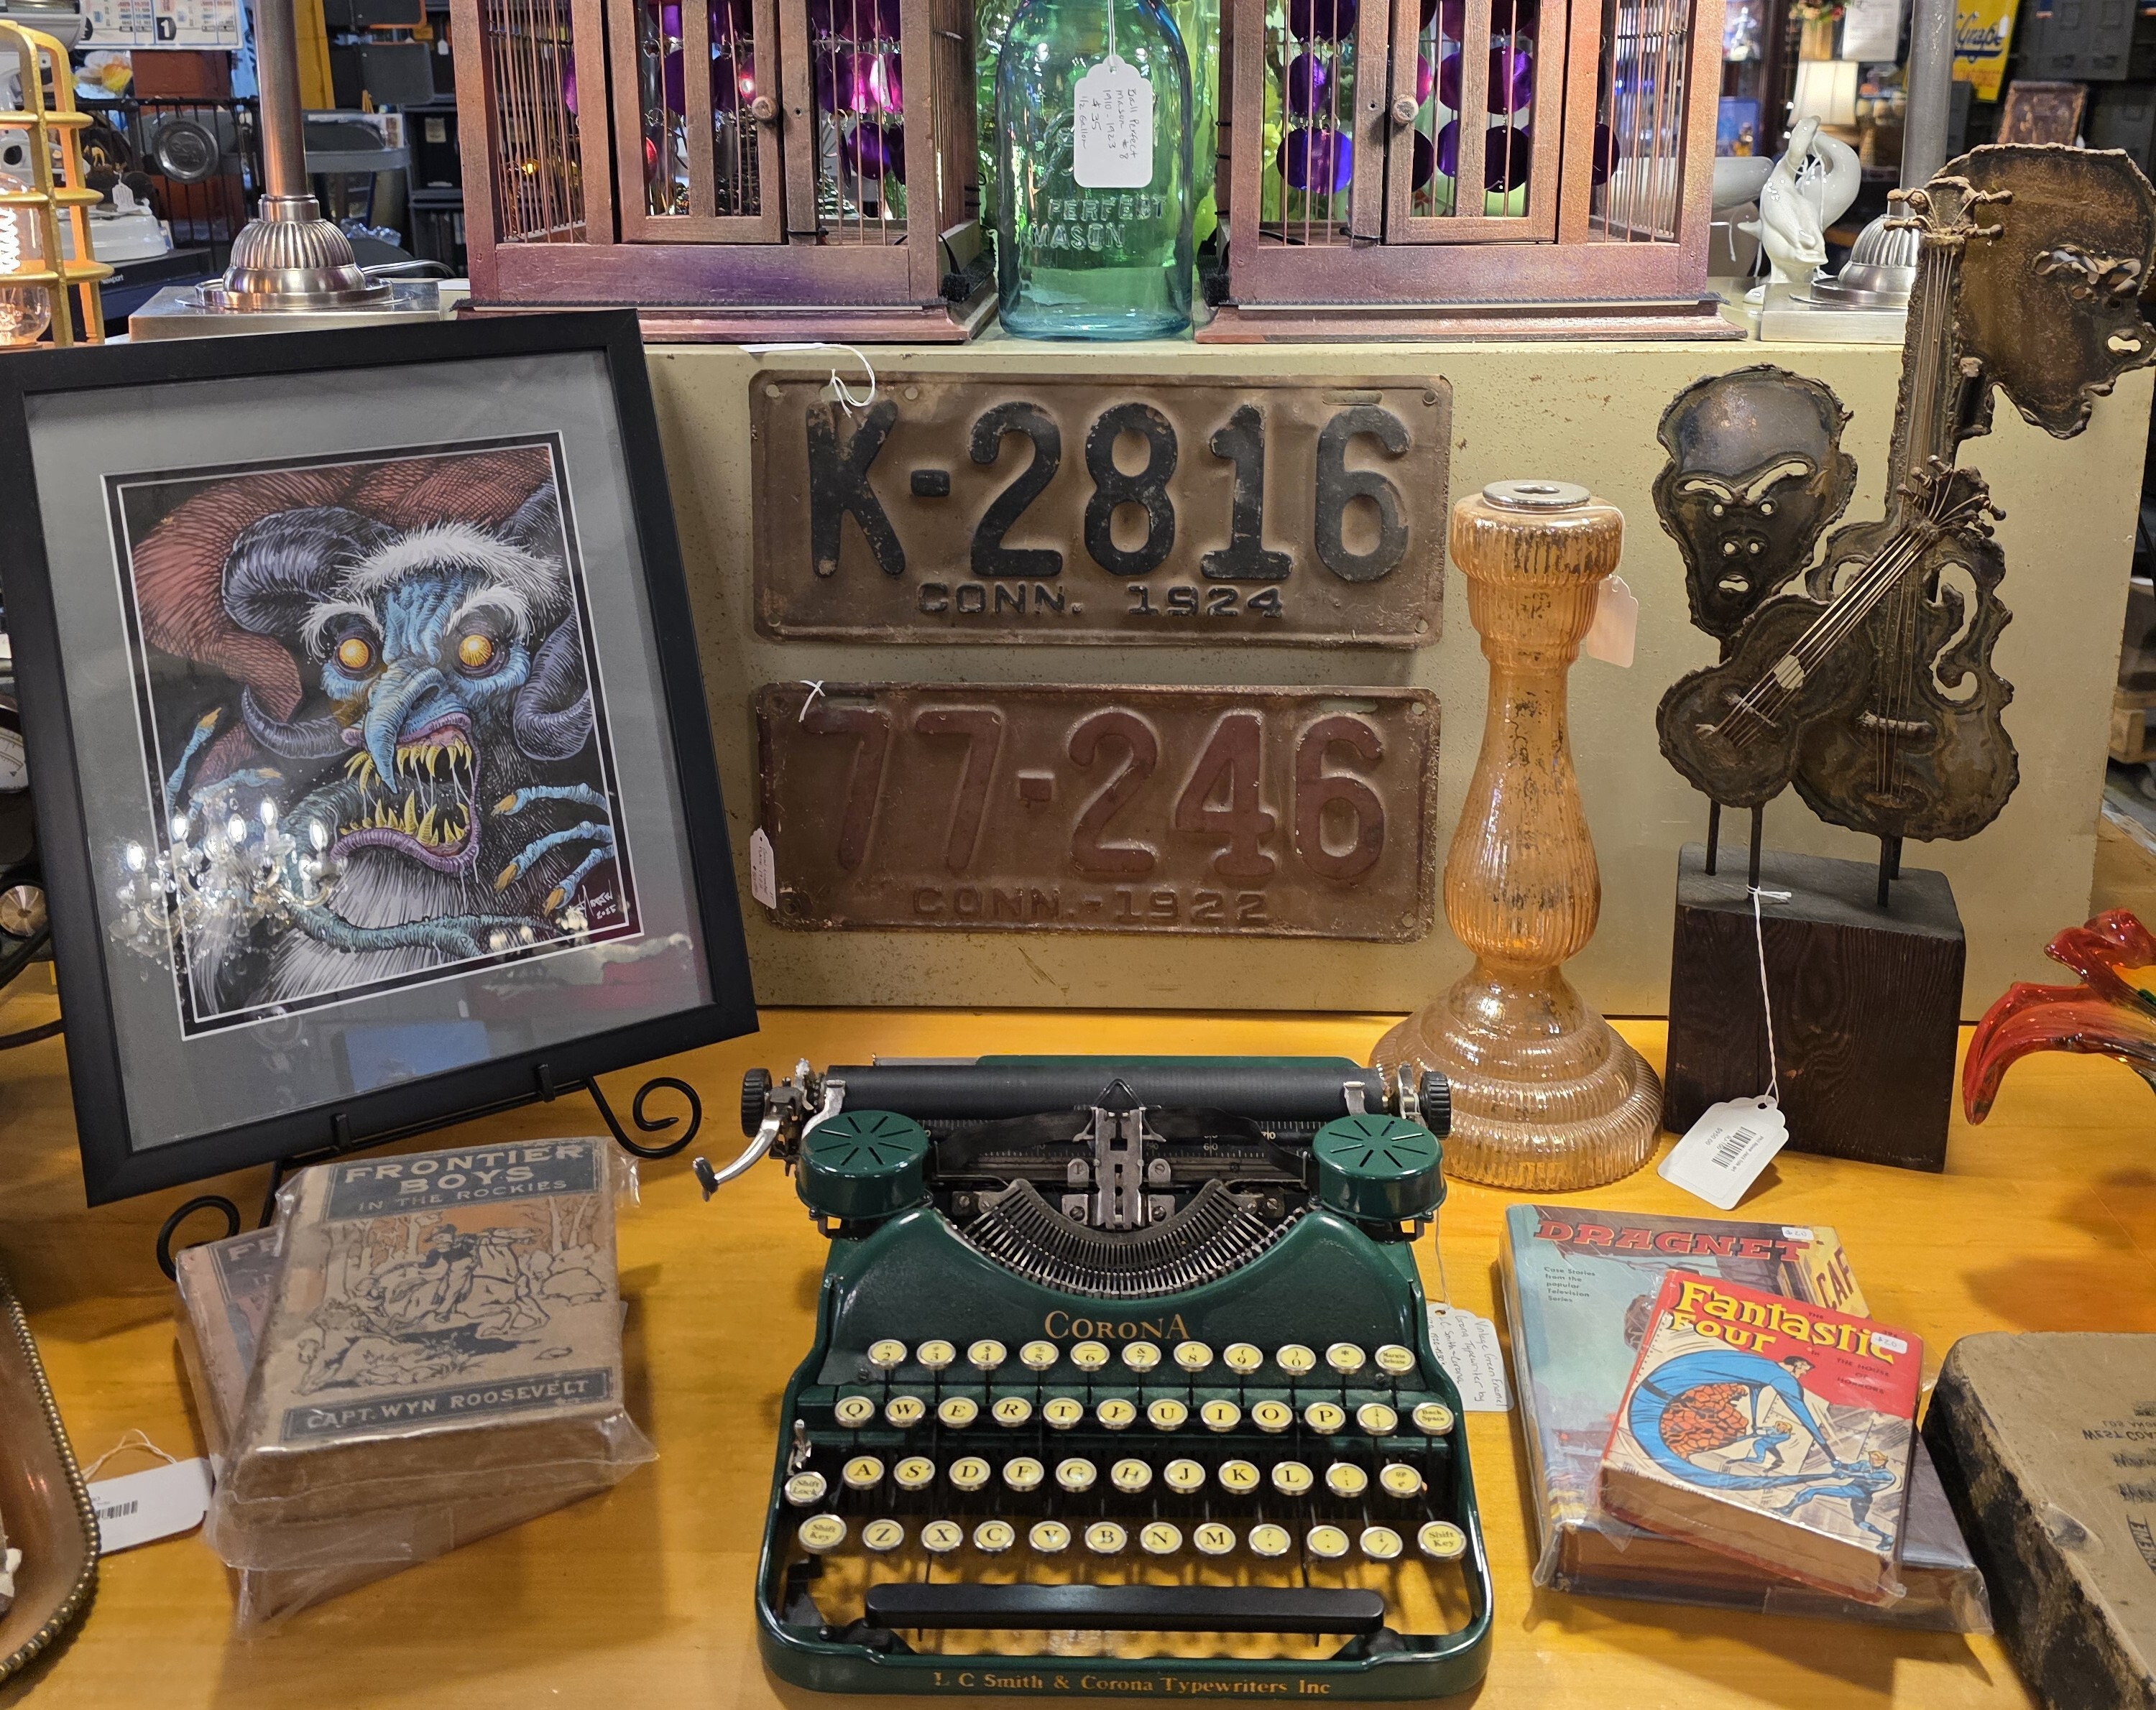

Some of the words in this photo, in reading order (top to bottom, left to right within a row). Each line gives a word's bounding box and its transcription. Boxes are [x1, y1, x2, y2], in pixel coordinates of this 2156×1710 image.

[160, 19, 170, 38] 1
[1102, 90, 1112, 109] 1910
[1128, 88, 1138, 113] Ball
[1105, 123, 1116, 149] 1923
[1128, 119, 1140, 159] Perfect
[1047, 194, 1167, 222] PERFECT
[1028, 222, 1125, 251] MASON
[806, 399, 1412, 583] K-2816
[917, 583, 1083, 616] CONN.
[1128, 583, 1284, 619] 1924
[802, 707, 1385, 879] 77-246
[345, 1144, 586, 1184] FRONTIER
[400, 1166, 535, 1195] BOYS
[359, 1200, 384, 1212] IN
[397, 1194, 443, 1207] THE
[460, 1180, 568, 1201] ROCKIES
[1534, 1219, 1810, 1262] DRAGNET
[1567, 1267, 1596, 1277] Stories
[1547, 1288, 1590, 1298] Television
[1674, 1280, 1895, 1366] Fantastic
[882, 1352, 891, 1361] 2
[931, 1352, 939, 1361] 3
[981, 1353, 990, 1362] 4
[1033, 1354, 1043, 1362] 5
[1085, 1354, 1095, 1363] 6
[1137, 1355, 1145, 1364] 7
[1187, 1354, 1197, 1363] 8
[1236, 1357, 1247, 1365] 9
[1484, 1353, 1498, 1377] Green
[1836, 1357, 1853, 1366] THE
[1857, 1364, 1890, 1377] HOUSE
[1461, 1339, 1483, 1389] Typewriter
[1474, 1391, 1487, 1402] by
[307, 1408, 377, 1429] CAPT.
[382, 1398, 437, 1418] WYN
[450, 1380, 589, 1410] ROOSEVELT
[845, 1402, 864, 1418] Q
[894, 1403, 915, 1415] W
[949, 1405, 967, 1418] E
[1002, 1403, 1018, 1416] R
[1054, 1405, 1072, 1418] T
[1111, 1405, 1128, 1418] Y
[1160, 1408, 1176, 1420] U
[1216, 1408, 1225, 1420] I
[1261, 1408, 1280, 1420] O
[1318, 1410, 1334, 1423] P
[794, 1479, 820, 1489] Shift
[854, 1464, 872, 1476] A
[905, 1465, 922, 1478] S
[962, 1465, 979, 1478] D
[1016, 1465, 1033, 1478] F
[1067, 1466, 1083, 1479] G
[1122, 1467, 1141, 1481] H
[1179, 1467, 1191, 1481] J
[1233, 1469, 1250, 1482] K
[1285, 1469, 1299, 1483] L
[792, 1486, 819, 1496] Lock
[809, 1531, 831, 1543] Key
[811, 1523, 837, 1533] Shift
[875, 1528, 890, 1542] Z
[933, 1528, 952, 1543] X
[986, 1528, 1003, 1542] C
[1043, 1530, 1059, 1543] V
[1100, 1530, 1115, 1544] B
[1151, 1531, 1169, 1545] N
[1205, 1531, 1225, 1545] M
[1429, 1531, 1454, 1540] Shift
[1432, 1539, 1455, 1548] Key
[958, 1672, 975, 1687] C
[983, 1673, 1044, 1689] Smith
[1053, 1674, 1071, 1689] &
[1080, 1675, 1153, 1692] Corona
[1159, 1676, 1288, 1695] Typewriters
[1299, 1679, 1331, 1695] Inc
